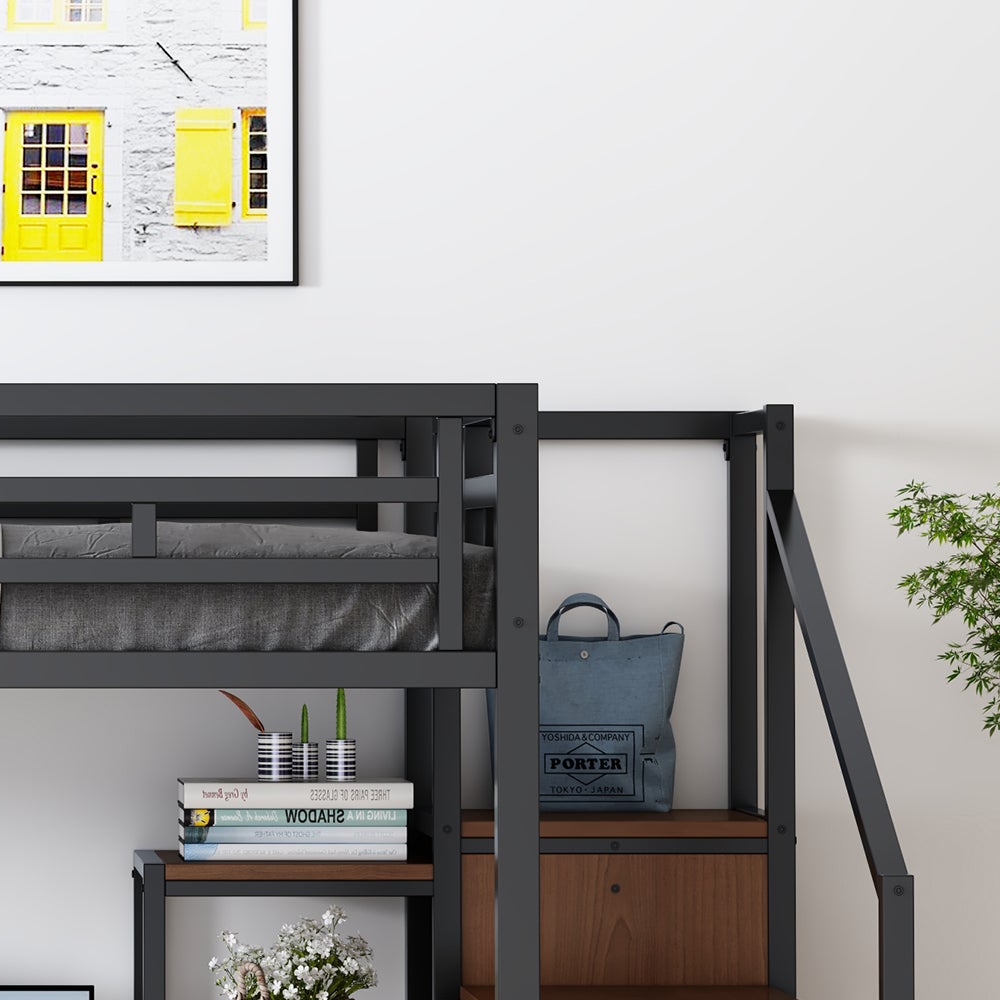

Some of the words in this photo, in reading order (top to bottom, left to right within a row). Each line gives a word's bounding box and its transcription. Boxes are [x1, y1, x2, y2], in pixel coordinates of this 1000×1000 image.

[550, 758, 622, 770] PORTER
[550, 785, 583, 794] TOKYO
[590, 785, 624, 794] JAPAN
